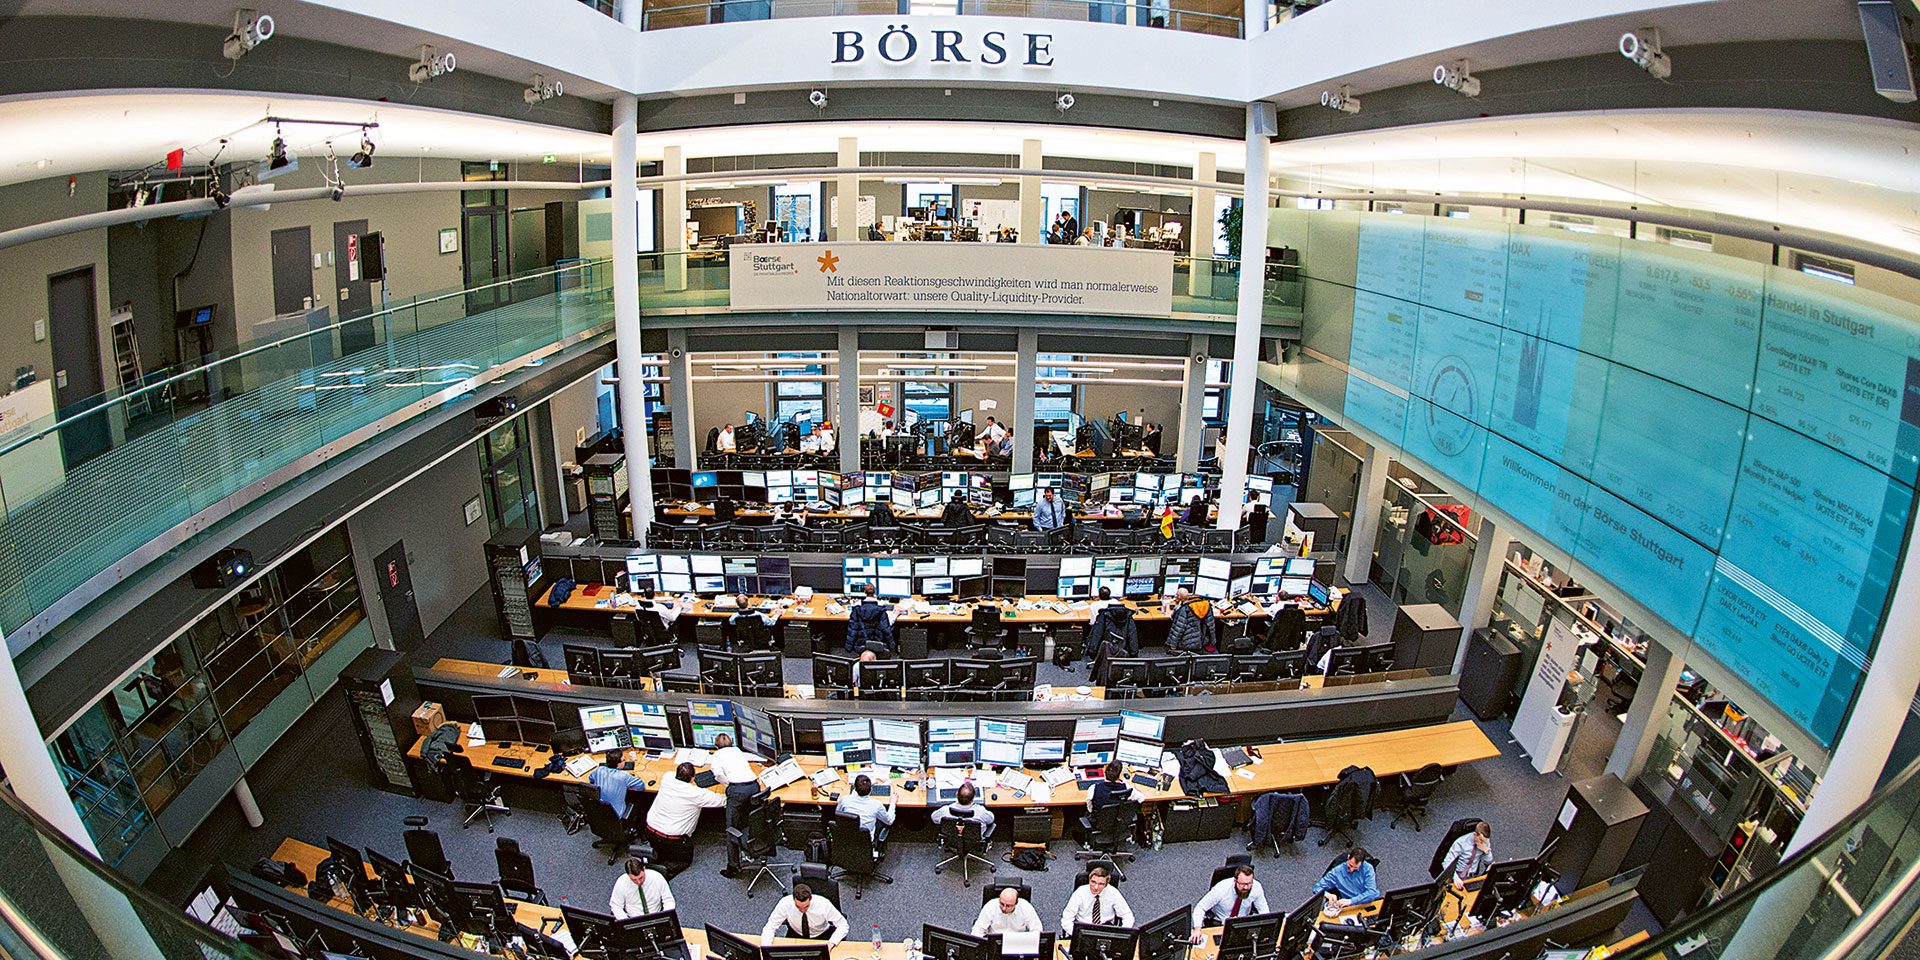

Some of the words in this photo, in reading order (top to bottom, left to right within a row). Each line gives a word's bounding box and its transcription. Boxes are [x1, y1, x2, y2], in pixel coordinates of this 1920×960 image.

[831, 24, 1054, 66] BÖRSE
[1511, 242, 1530, 257] DAX
[753, 262, 794, 272] Stuttgart
[827, 276, 844, 287] Mit
[847, 275, 881, 287] diesen
[884, 276, 1032, 291] Reaktionsgeschwindigkeiten
[1034, 279, 1057, 290] wird
[1060, 280, 1083, 291] man
[1086, 280, 1159, 294] normalerweise
[827, 290, 910, 301] Nationaltorwart:
[913, 292, 948, 302] unsere
[951, 291, 1085, 305] Quality-Liquidity-Provider.
[1767, 293, 1807, 317] Handel
[1809, 304, 1820, 321] in
[1822, 309, 1875, 339] Stuttgart
[1502, 456, 1557, 494] Willkommen
[1557, 488, 1571, 504] an
[1572, 495, 1592, 514] der
[1593, 505, 1628, 536] Börse
[1628, 527, 1685, 571] Stuttgart
